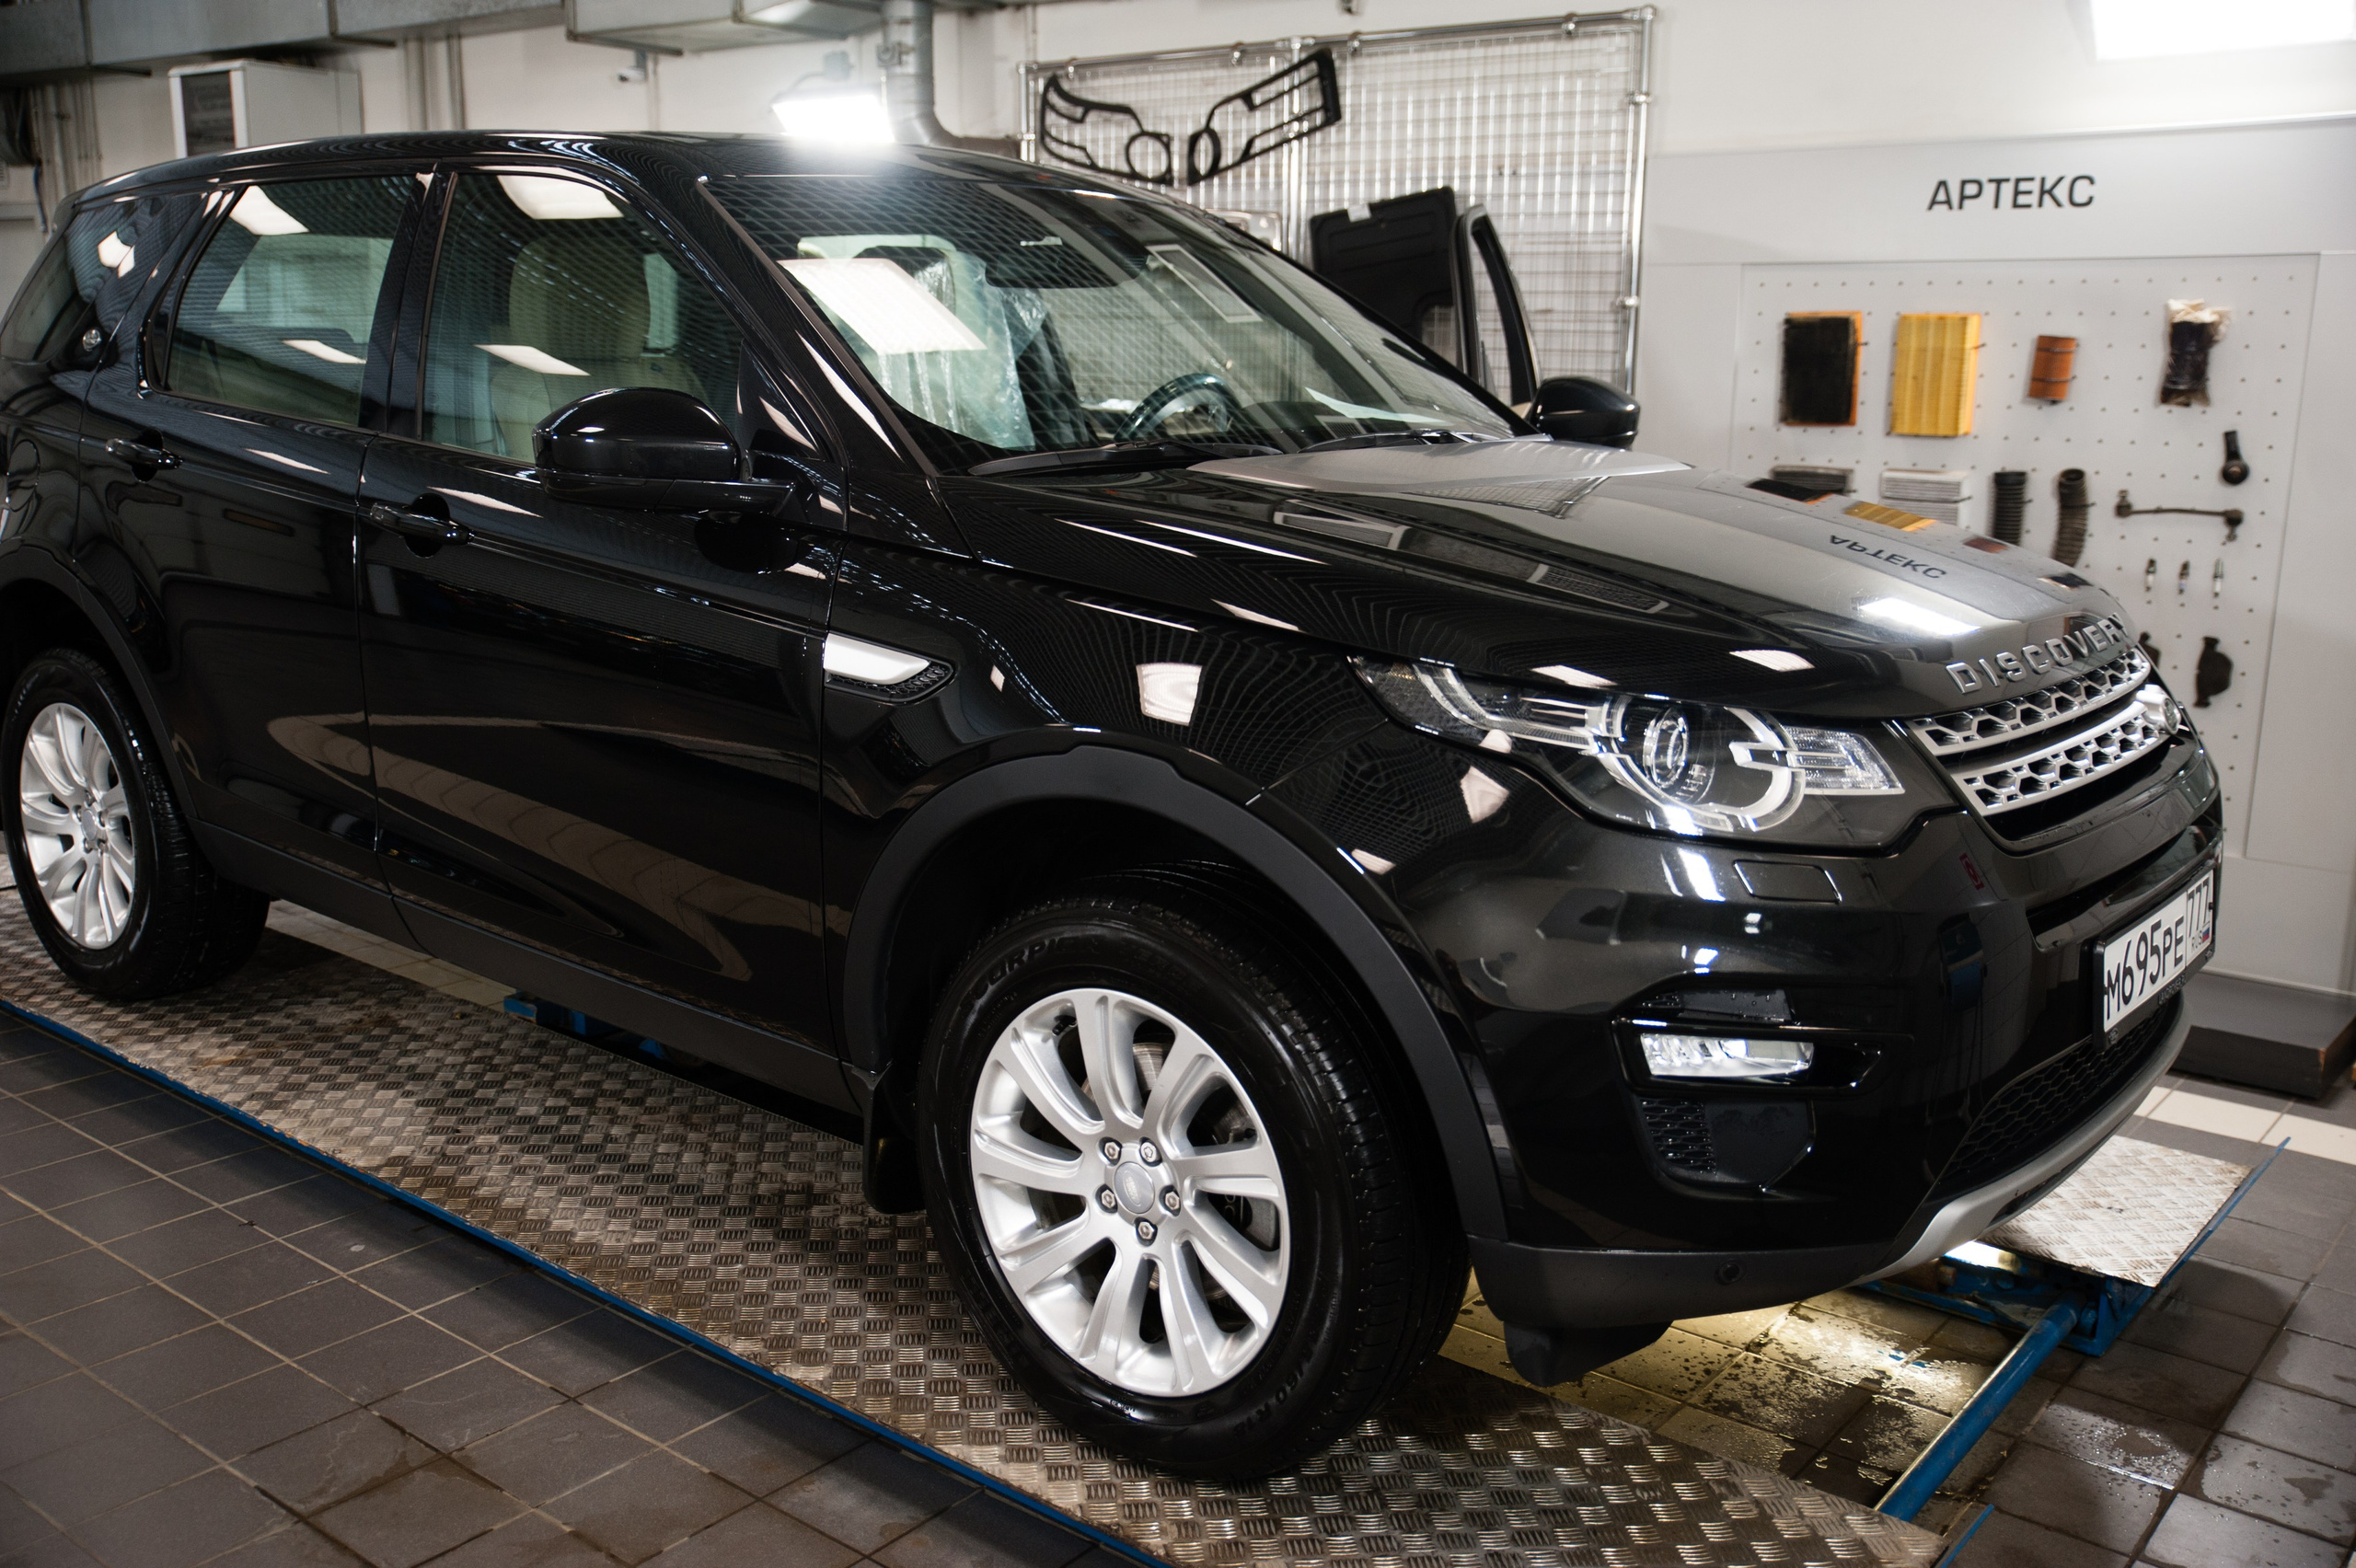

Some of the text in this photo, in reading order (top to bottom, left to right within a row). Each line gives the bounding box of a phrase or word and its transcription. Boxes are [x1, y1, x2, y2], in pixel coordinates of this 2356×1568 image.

[1926, 175, 2096, 211] АРТЕКС
[1946, 612, 2129, 694] DISCOVERY
[2188, 876, 2210, 939] 777
